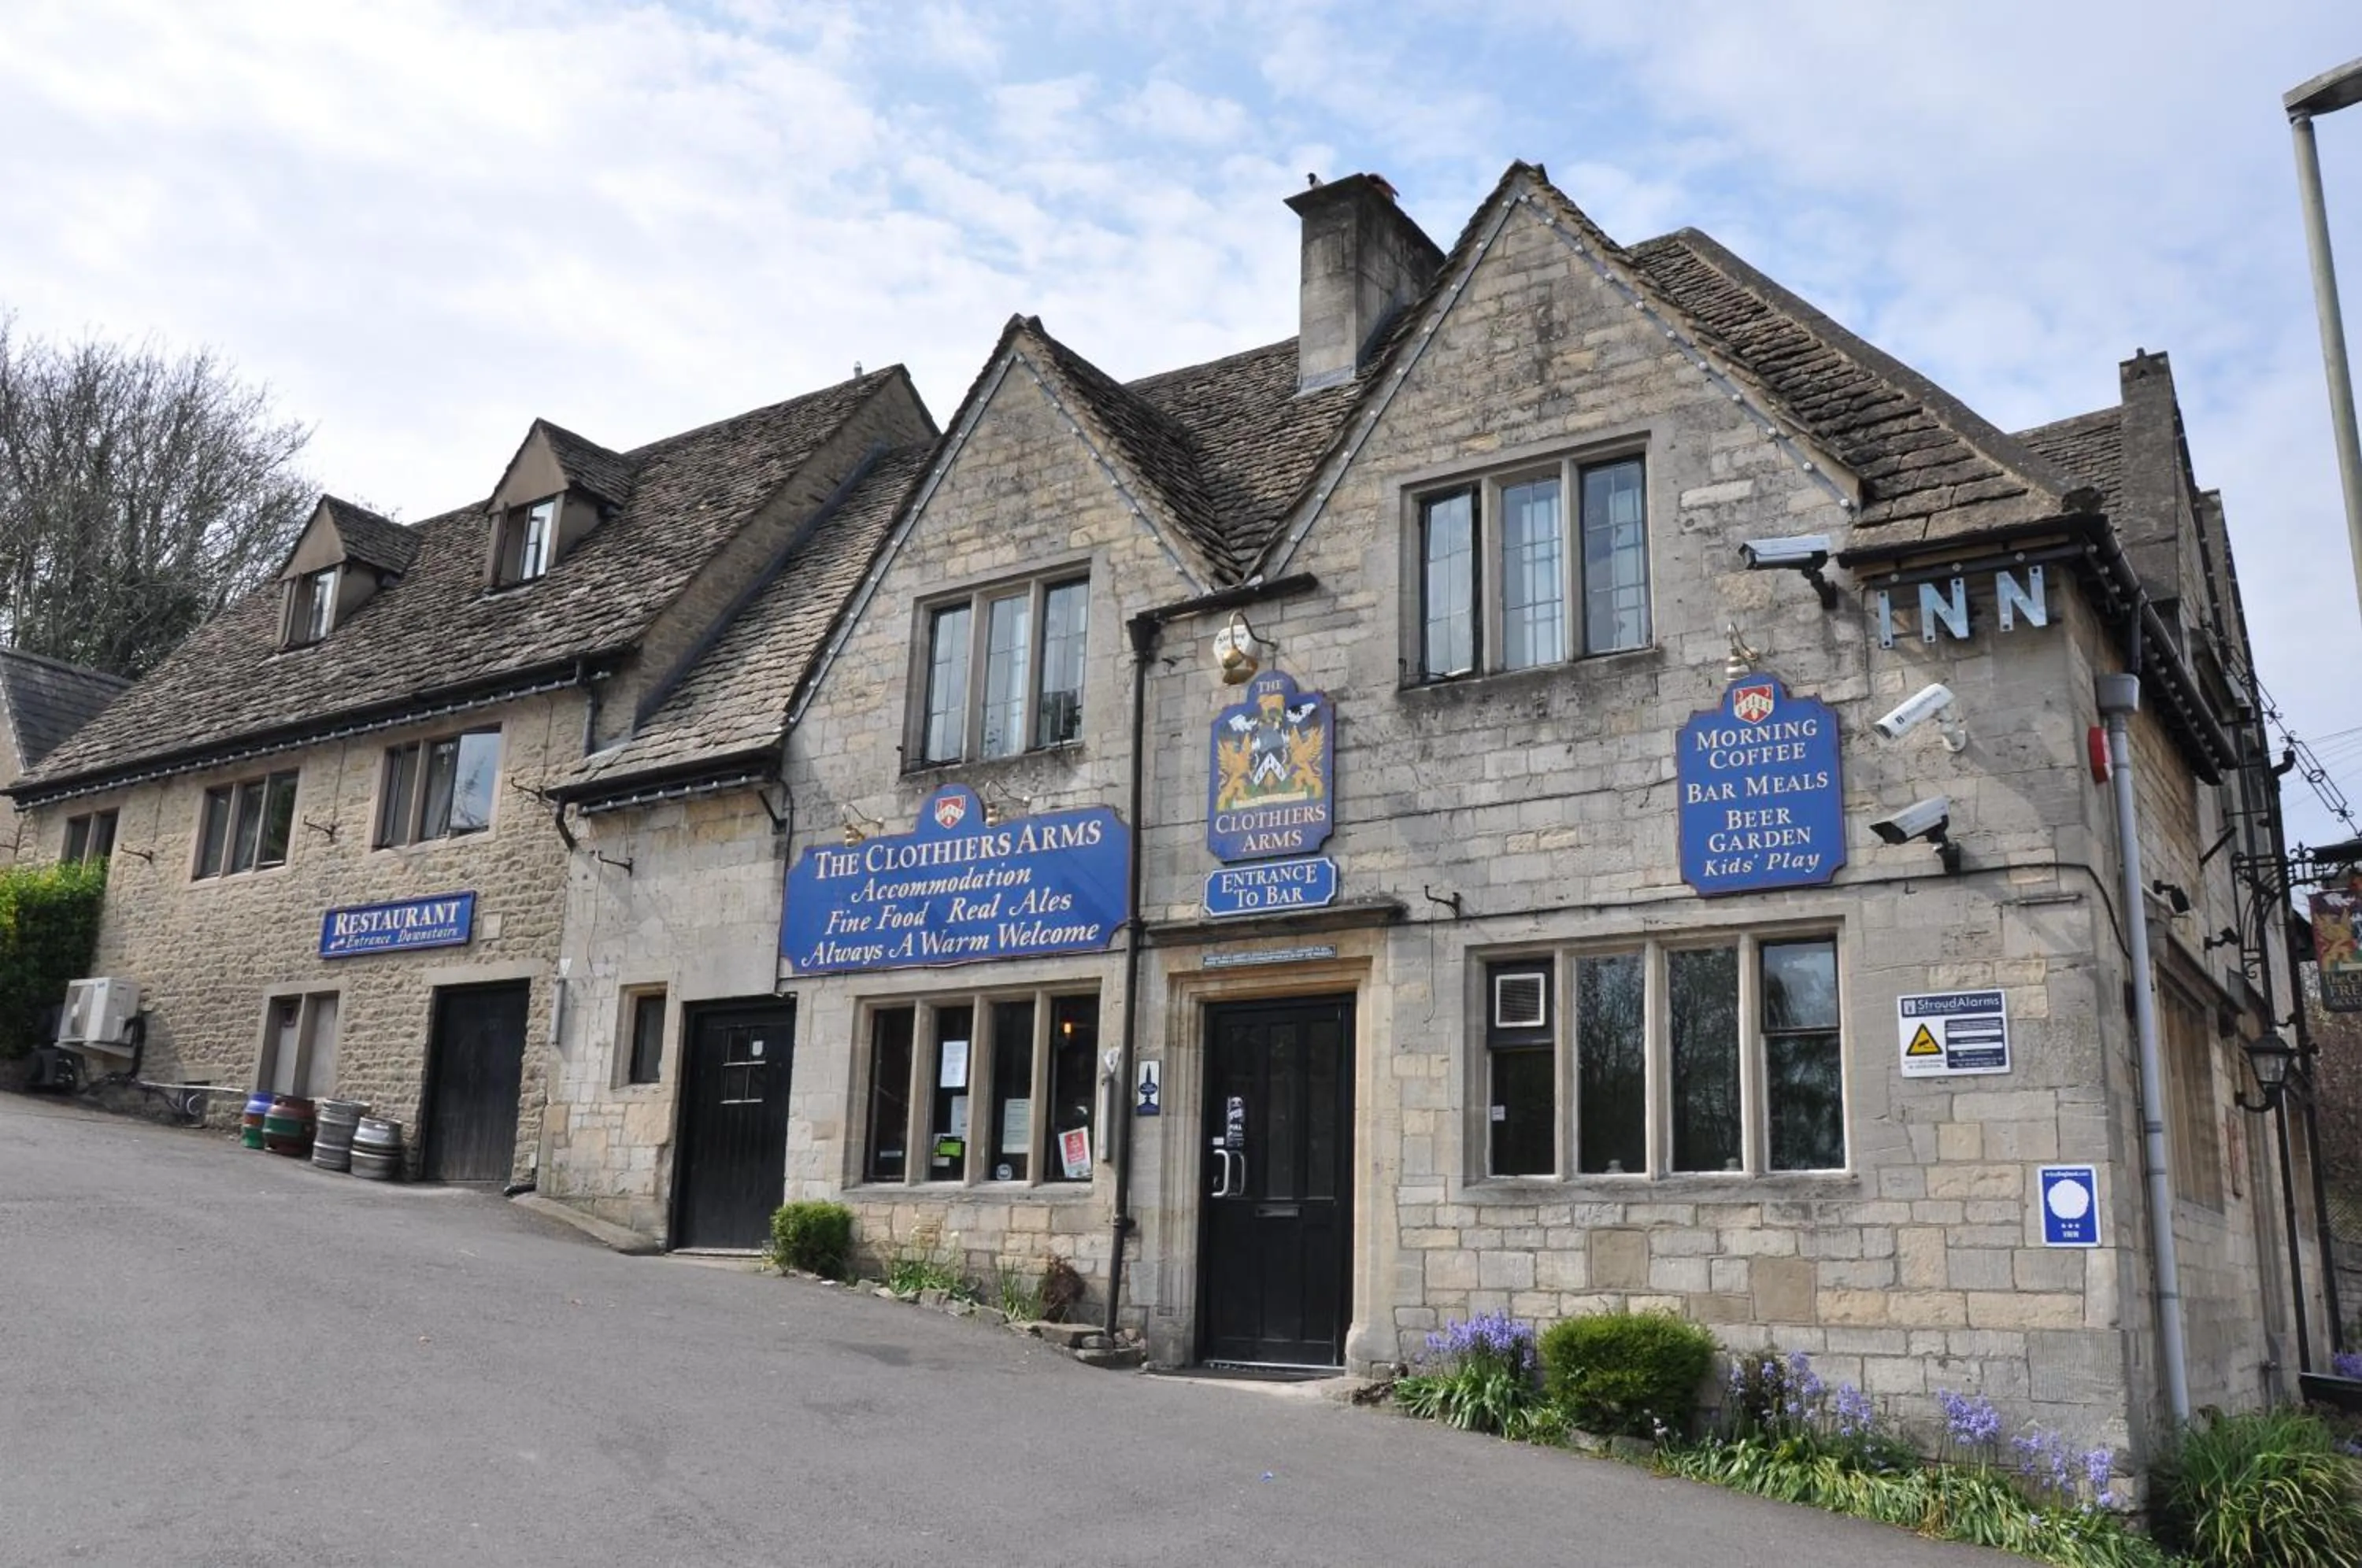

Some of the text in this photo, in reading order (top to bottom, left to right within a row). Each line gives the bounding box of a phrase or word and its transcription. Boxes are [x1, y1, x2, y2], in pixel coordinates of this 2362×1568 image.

[1877, 565, 2047, 649] INN
[1257, 679, 1284, 693] THE
[1696, 719, 1818, 751] MORNING
[1709, 742, 1806, 770] COFFEE
[1686, 771, 1828, 804] BAR MEALS
[1216, 804, 1327, 834] CLOTHIERS
[1726, 808, 1792, 830] BEER
[815, 819, 1102, 880] THE CLOTHIERS ARMS
[1242, 830, 1303, 852] ARMS
[1708, 827, 1812, 853] GARDEN
[1767, 852, 1821, 874] Play
[851, 862, 1032, 904] Accommodation
[1221, 864, 1318, 894] ENTRANCE
[824, 886, 1073, 935] Fine Food Real Ales
[1266, 886, 1305, 905] BAR
[334, 902, 461, 936] RESTAURANT
[346, 927, 458, 949] Entrance Downstairs
[801, 920, 1101, 967] Always A Warm Welcome
